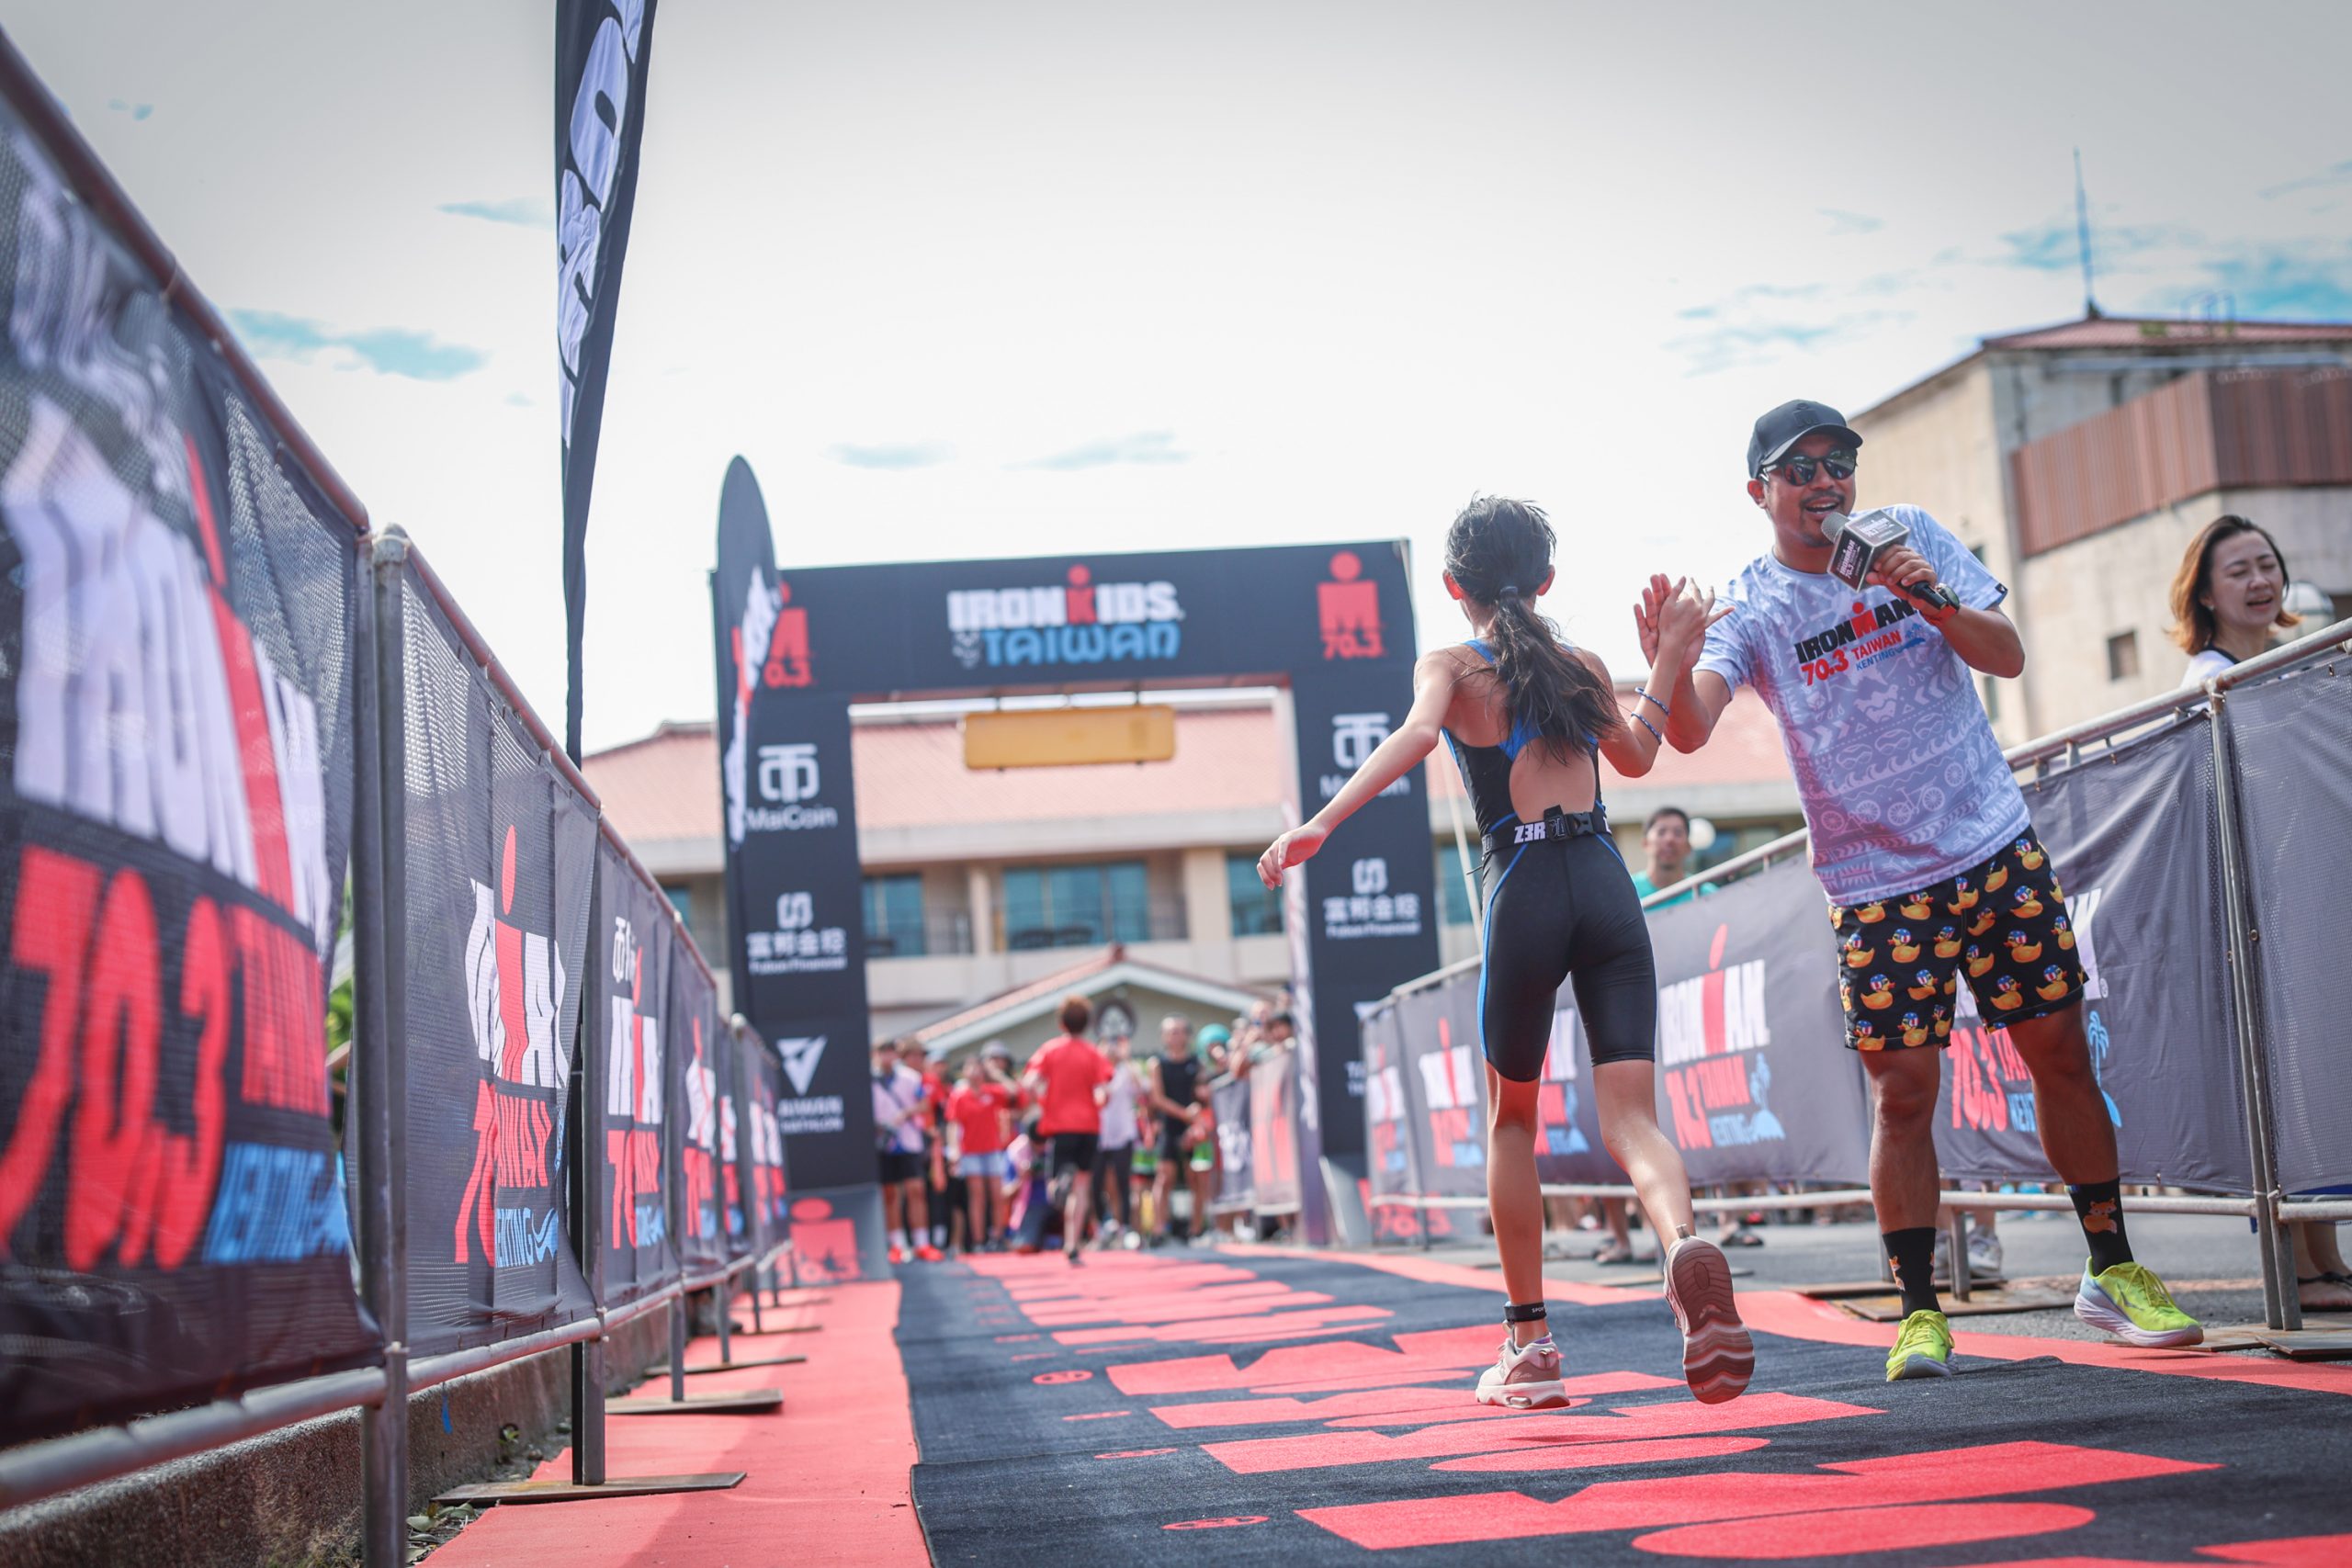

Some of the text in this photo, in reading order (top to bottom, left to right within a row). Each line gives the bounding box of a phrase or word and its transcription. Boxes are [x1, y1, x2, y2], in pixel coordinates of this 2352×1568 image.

[557, 0, 643, 448] IRO
[946, 564, 1179, 632] IRONKIDS
[982, 621, 1182, 667] TAIWAN
[1793, 599, 1916, 664] IRONMAN
[1801, 629, 1902, 686] 70.3 TAIWAN
[1856, 647, 1896, 671] KENTING
[763, 659, 813, 687] 0.3
[0, 847, 232, 1272] 70.3
[1947, 1026, 2008, 1132] 70.3
